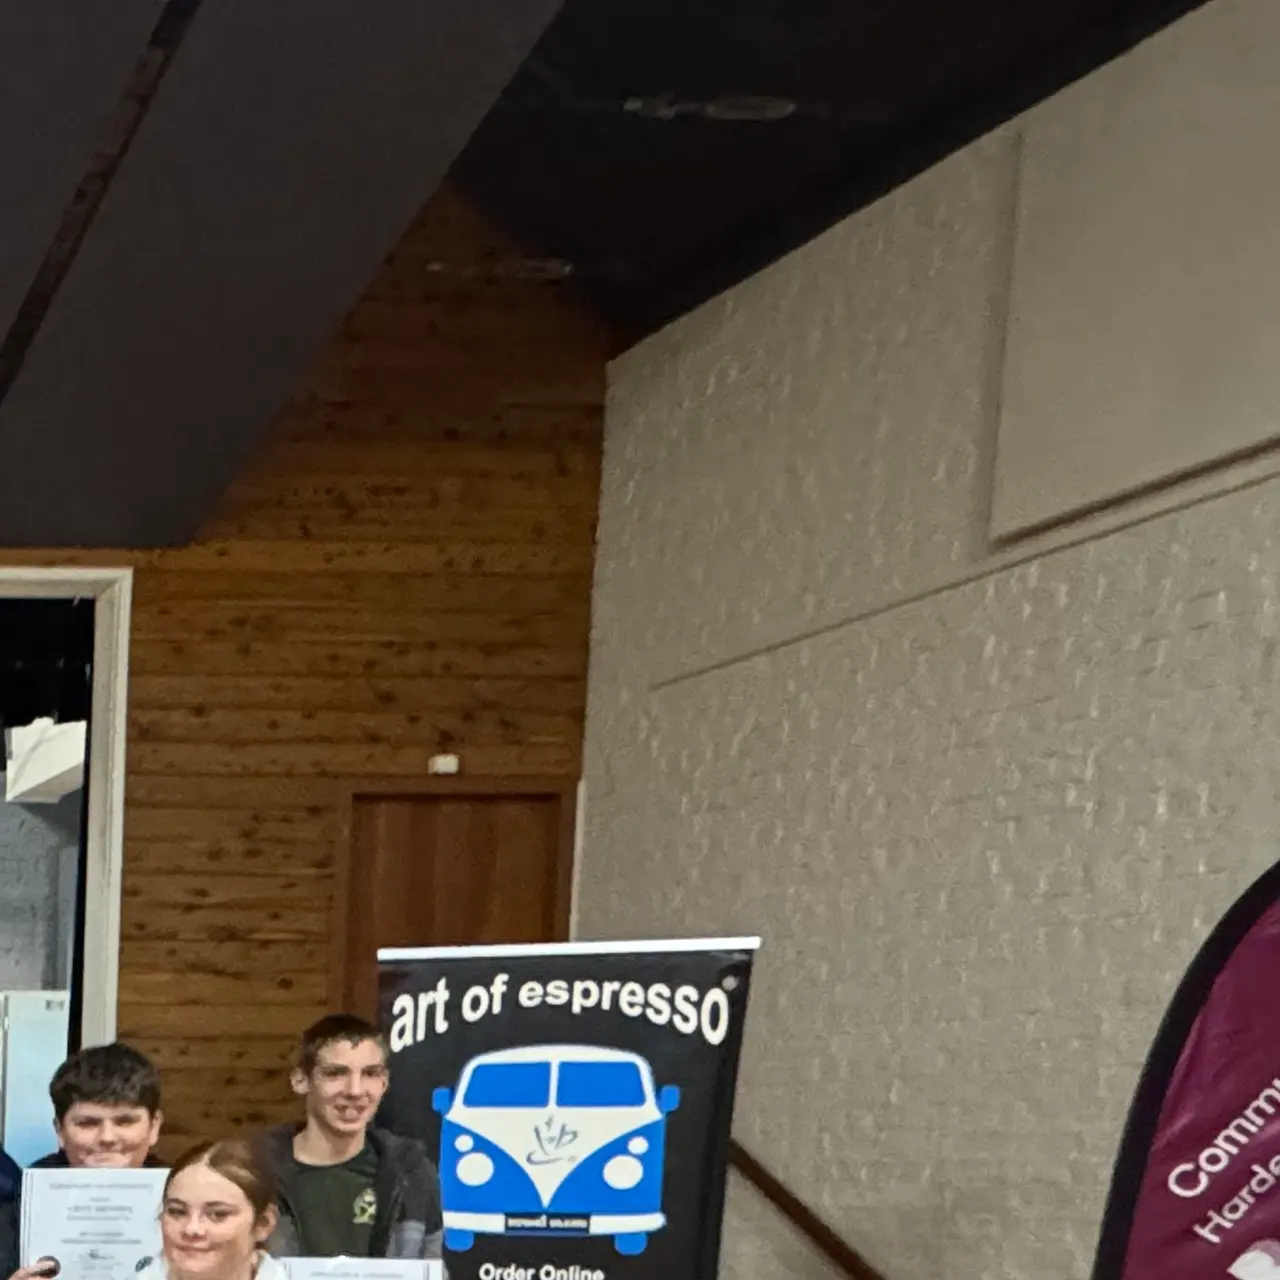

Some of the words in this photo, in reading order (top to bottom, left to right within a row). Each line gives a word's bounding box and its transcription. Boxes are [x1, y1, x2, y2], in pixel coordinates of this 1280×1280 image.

[390, 975, 449, 1053] art
[462, 973, 510, 1023] of
[518, 978, 729, 1046] espresso
